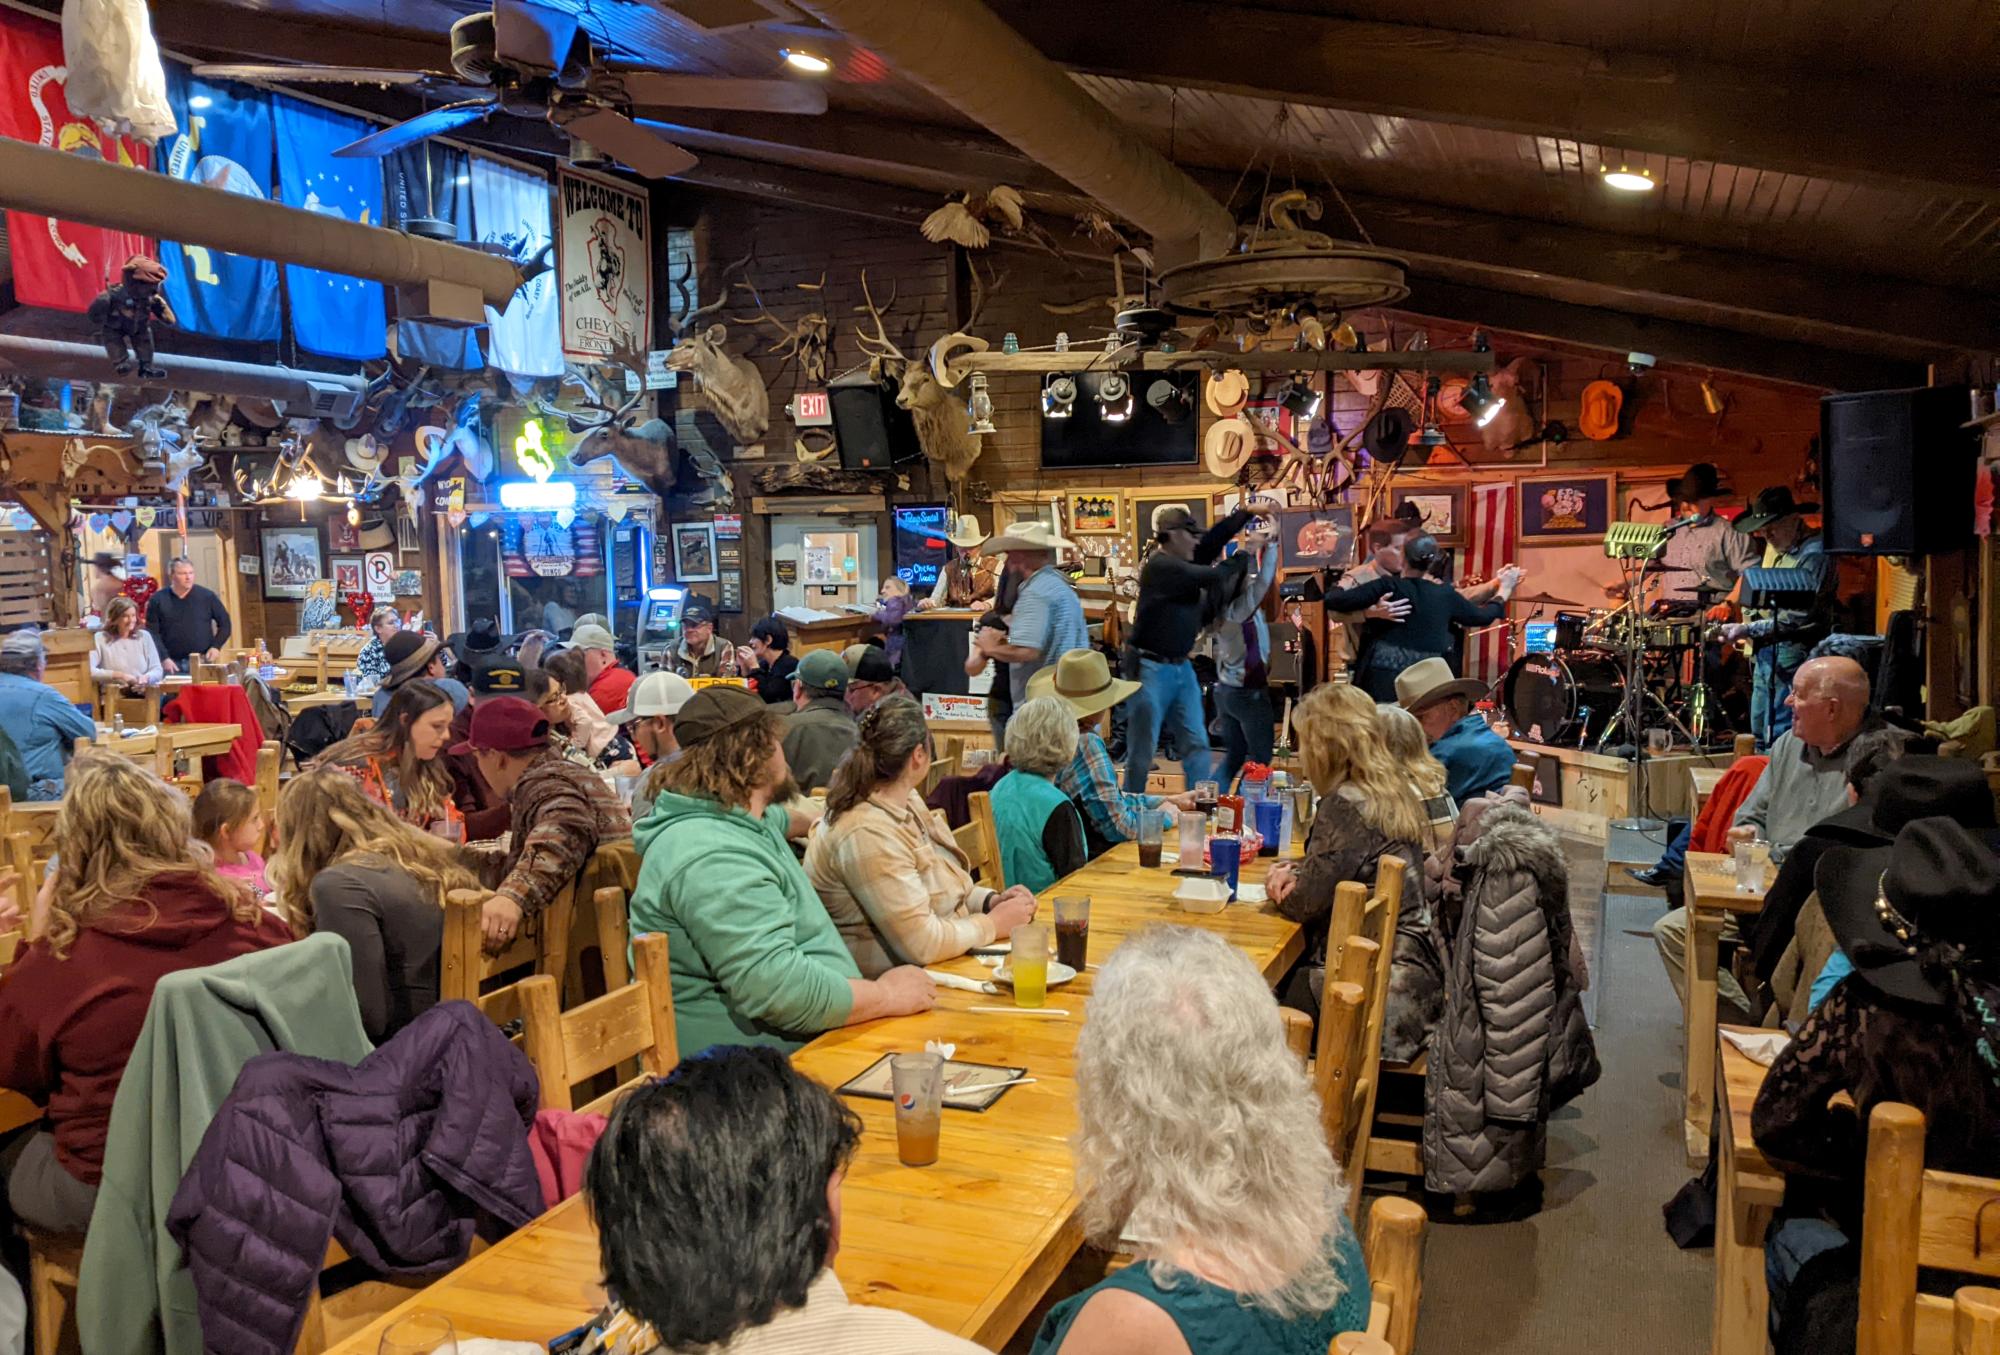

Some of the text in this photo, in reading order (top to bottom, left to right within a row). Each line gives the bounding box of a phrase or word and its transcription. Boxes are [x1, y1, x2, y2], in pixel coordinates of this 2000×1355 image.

[170, 140, 189, 176] UNITED
[399, 172, 407, 209] UNITED
[563, 174, 643, 241] WELCOME TO
[800, 395, 826, 417] EXIT
[202, 511, 223, 528] VIP
